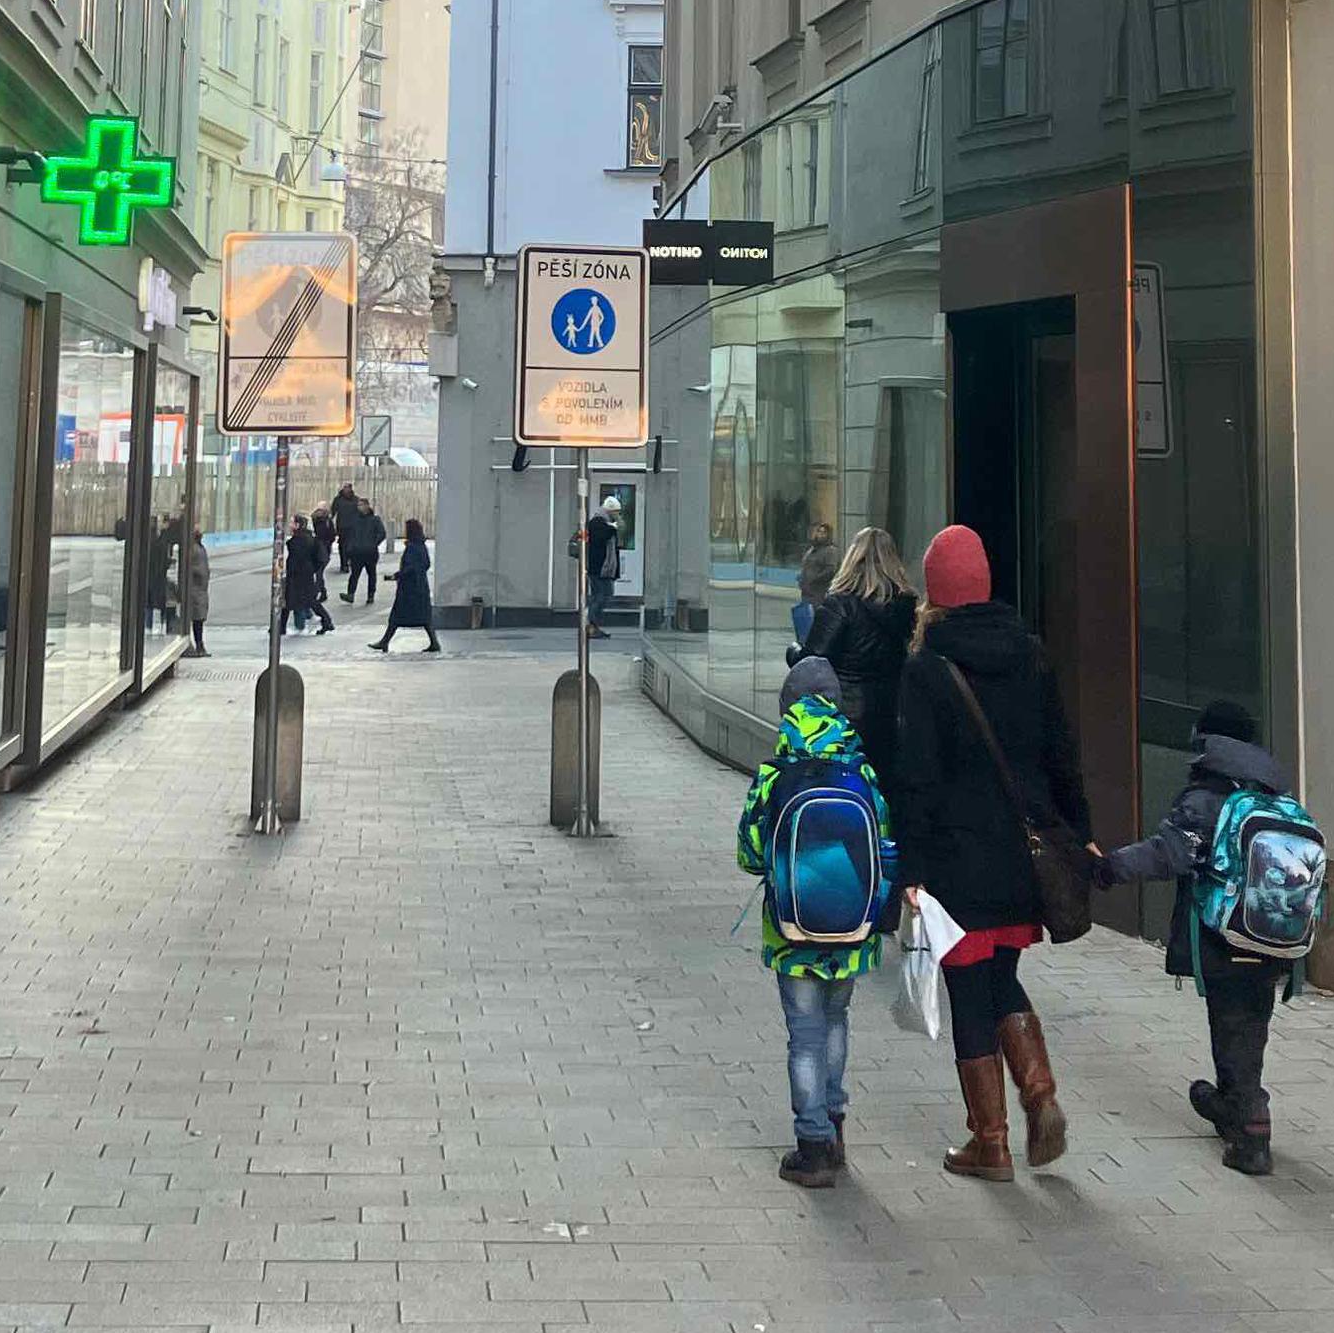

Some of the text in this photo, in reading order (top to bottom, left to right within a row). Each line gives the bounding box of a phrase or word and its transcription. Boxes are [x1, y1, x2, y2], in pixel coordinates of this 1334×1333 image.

[650, 246, 702, 258] NOTINO
[537, 258, 631, 280] PĚŠÍ ZÓNA
[558, 381, 608, 394] VOZIDLA
[542, 396, 624, 411] S POVOLENÍM
[556, 413, 572, 425] OD
